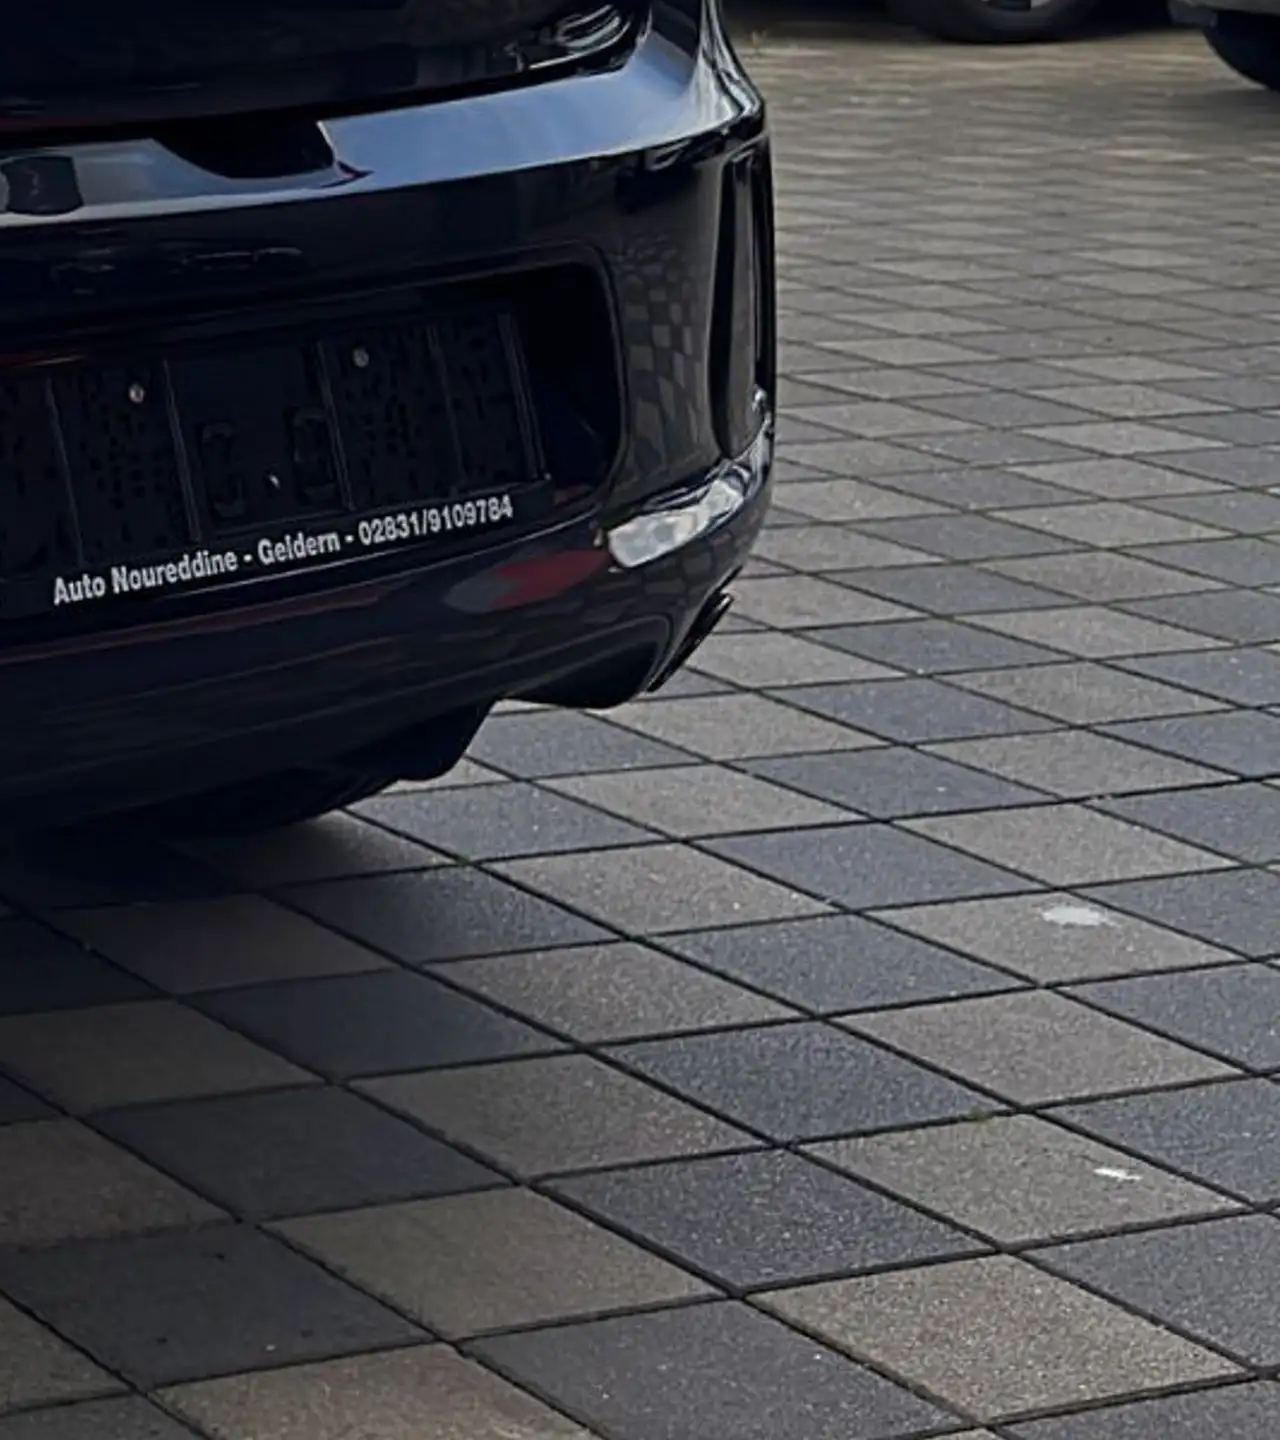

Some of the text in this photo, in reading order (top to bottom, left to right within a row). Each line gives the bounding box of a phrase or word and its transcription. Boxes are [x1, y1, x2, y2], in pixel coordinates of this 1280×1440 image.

[53, 573, 106, 606] Auto
[110, 550, 238, 594] Noureddine
[257, 531, 341, 565] Geldern
[358, 494, 514, 546] 02831/9109784
